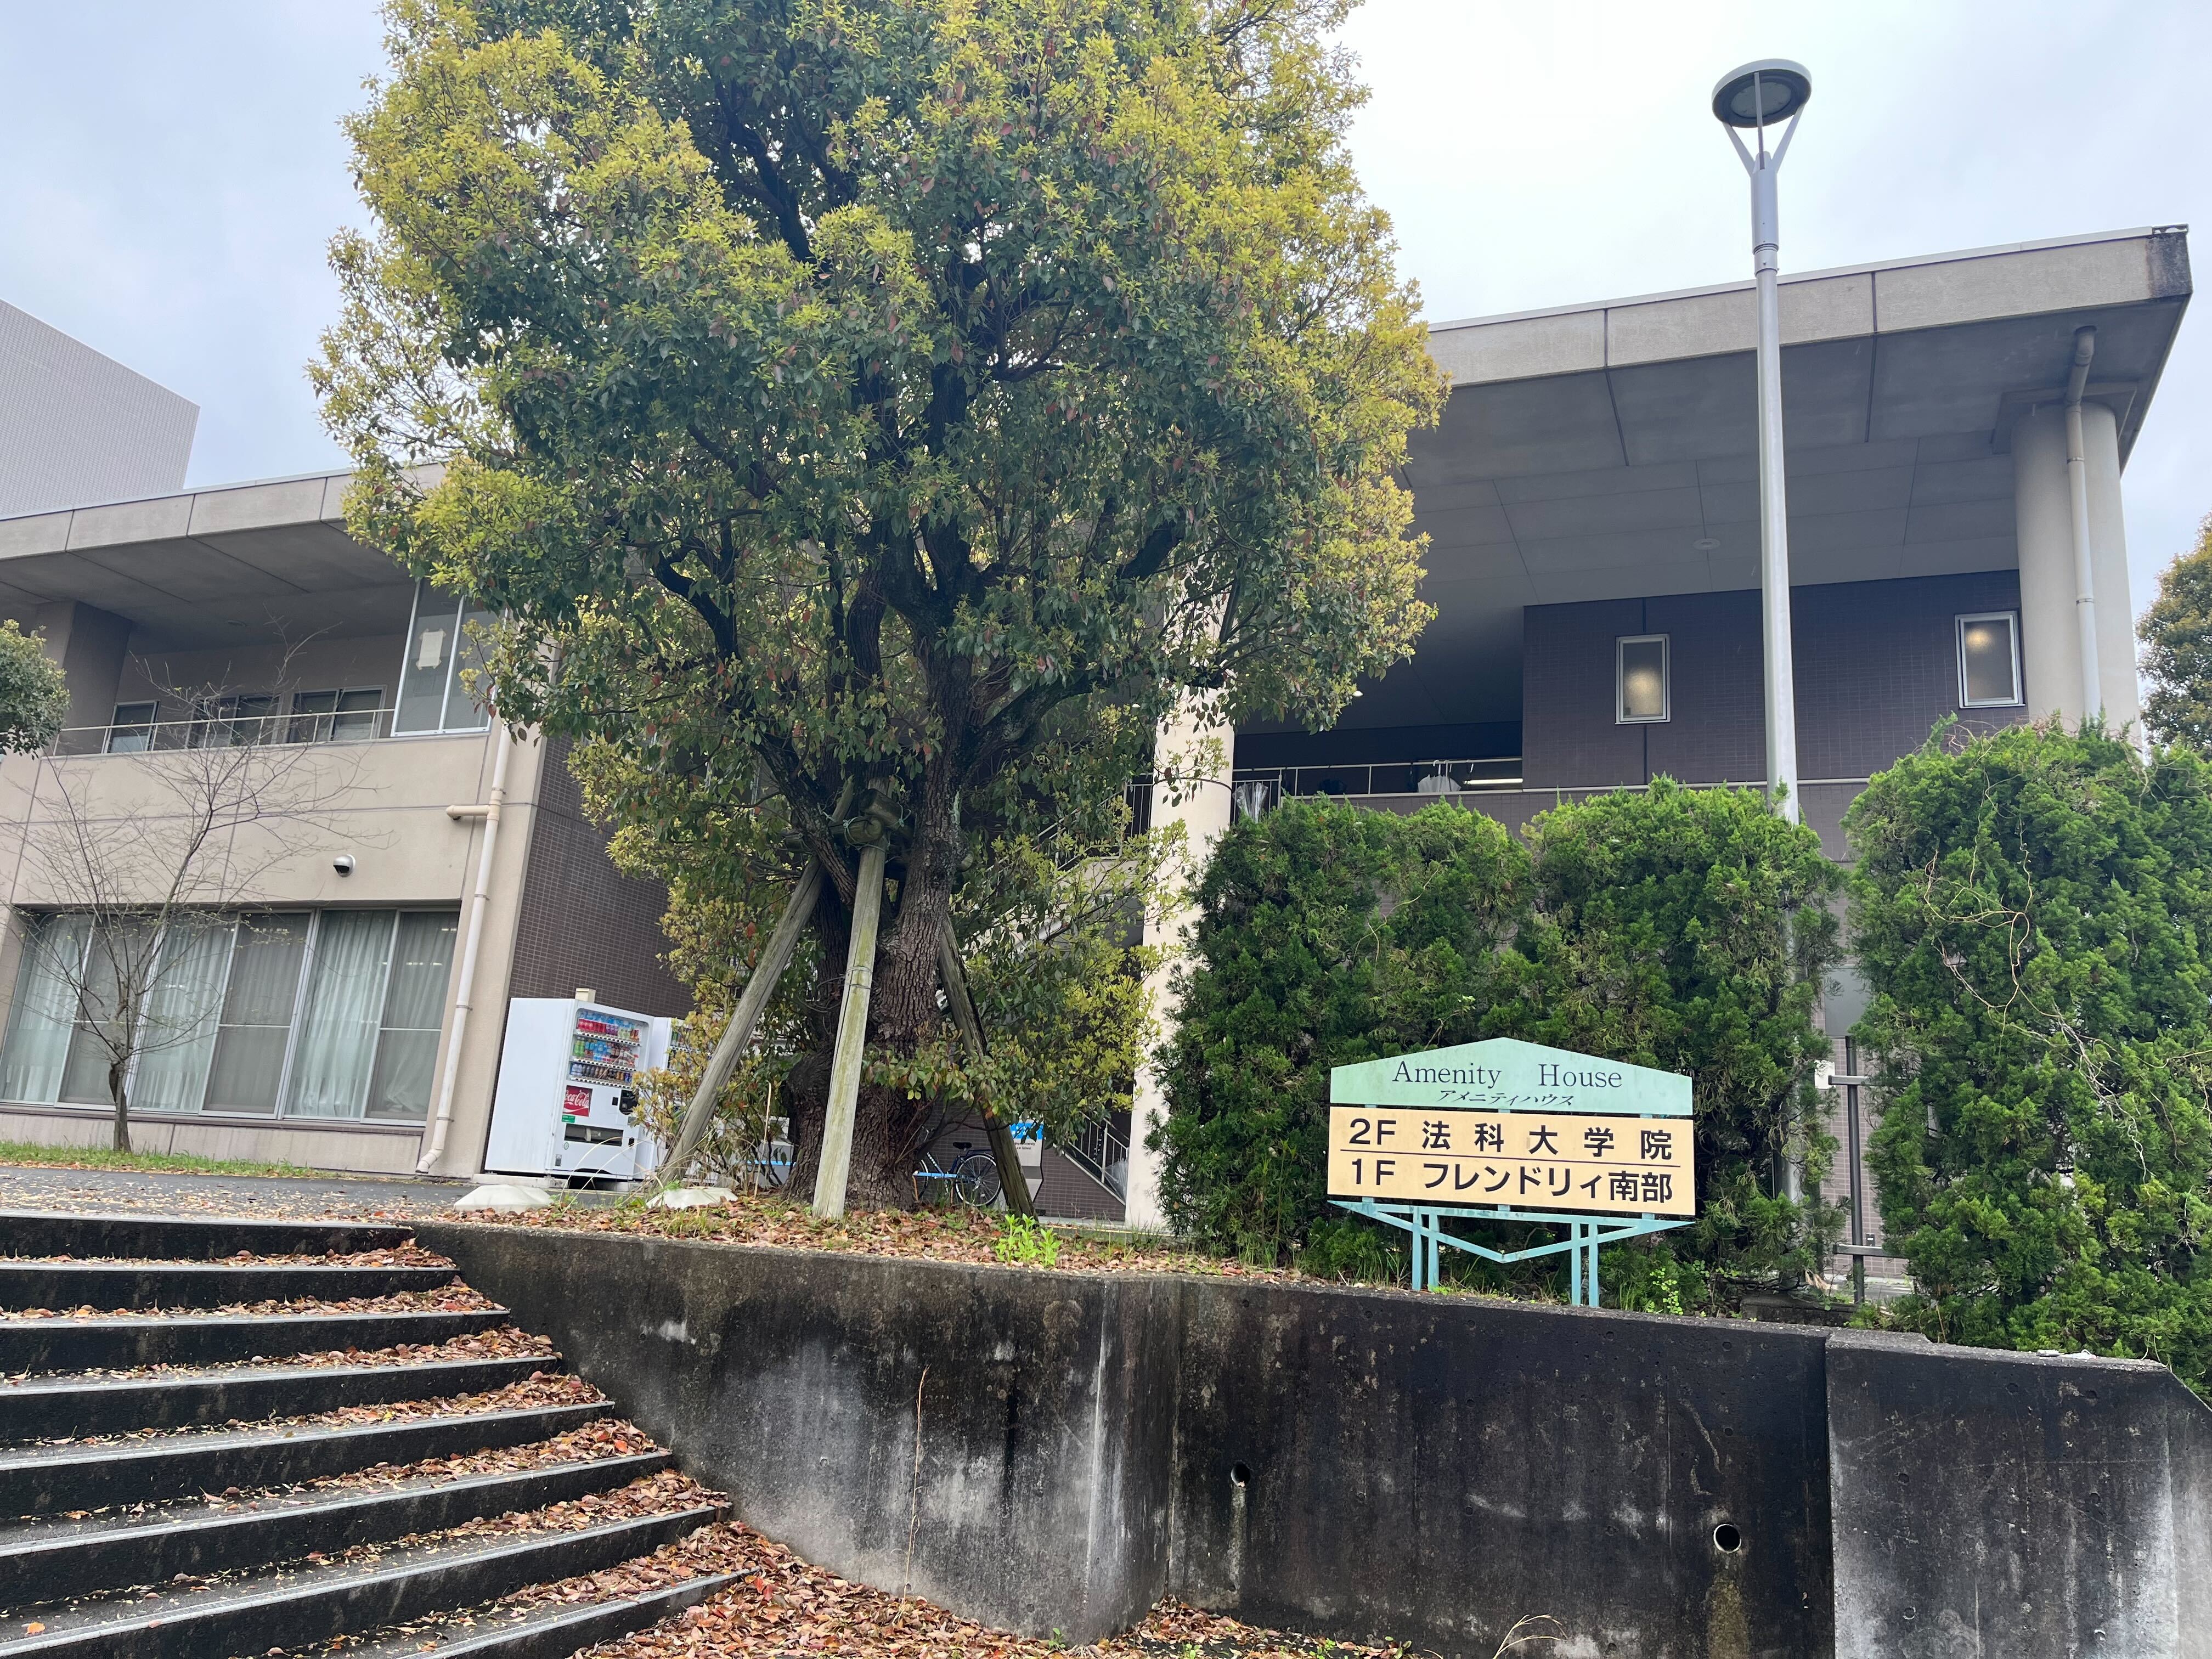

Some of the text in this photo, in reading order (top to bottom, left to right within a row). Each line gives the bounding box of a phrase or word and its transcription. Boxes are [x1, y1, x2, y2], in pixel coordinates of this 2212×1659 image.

[1392, 1061, 1623, 1089] Amenity House
[1435, 1090, 1575, 1107] アメニティハウス
[1349, 1119, 1672, 1161] 2F 法科大学院
[1352, 1159, 1673, 1203] 1F フレンドリィ南部
